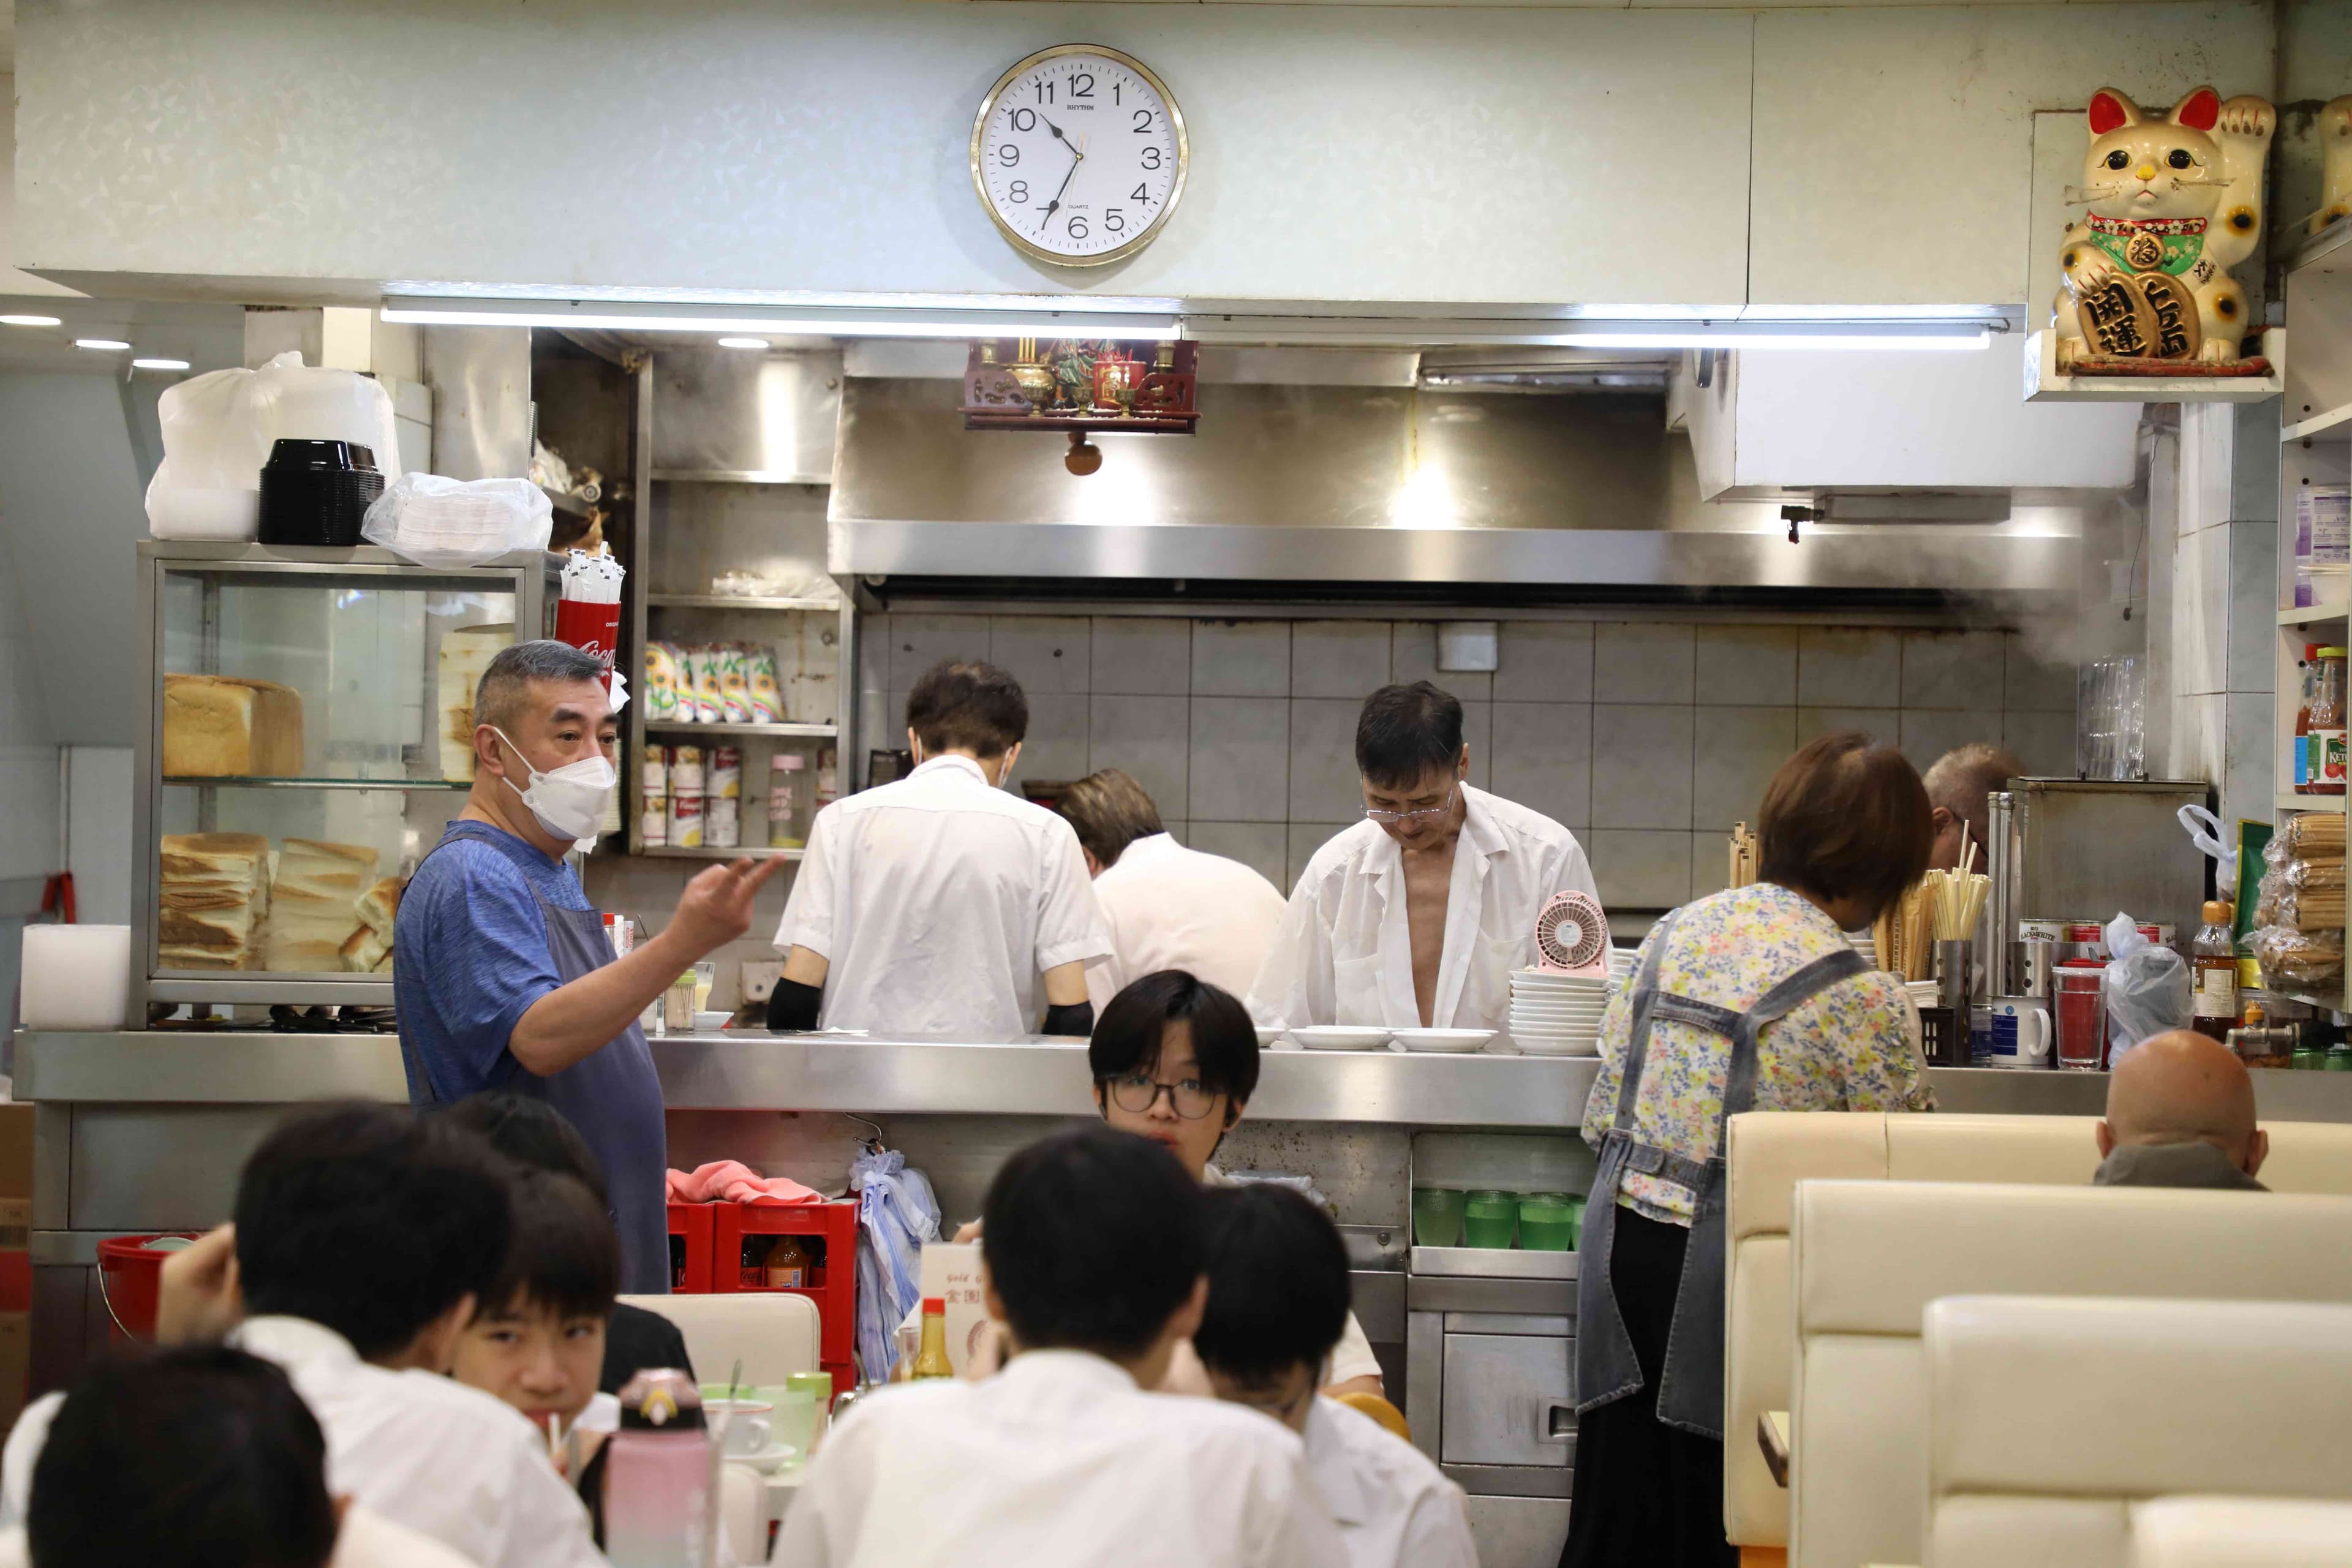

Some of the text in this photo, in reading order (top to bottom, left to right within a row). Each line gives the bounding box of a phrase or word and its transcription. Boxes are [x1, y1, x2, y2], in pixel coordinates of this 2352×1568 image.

[1035, 81, 1054, 104] 11
[1068, 74, 1095, 97] 12
[1113, 83, 1120, 106] 1
[1008, 108, 1036, 131] 10
[1133, 110, 1152, 133] 2
[999, 144, 1020, 167] 9
[1140, 146, 1161, 170] 3
[1009, 180, 1029, 203] 8
[1130, 183, 1150, 205] 4
[1068, 216, 1088, 239] 6
[1104, 208, 1125, 232] 5
